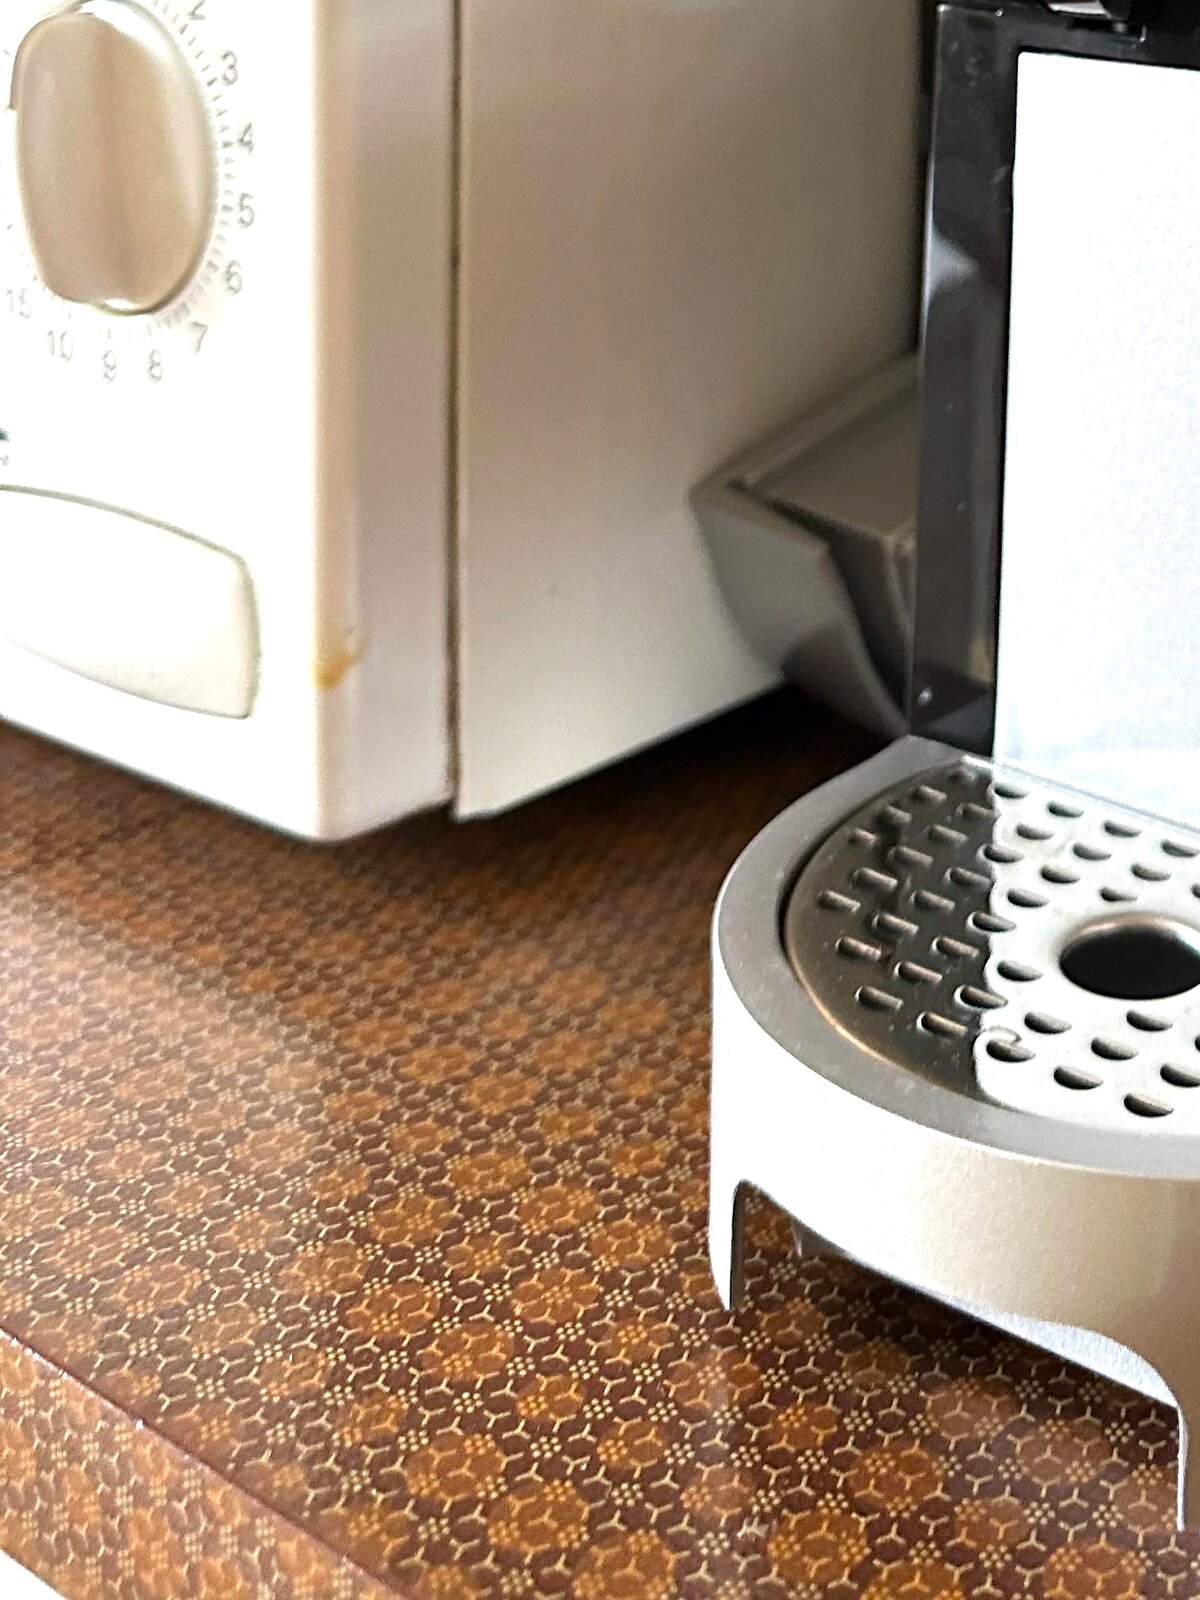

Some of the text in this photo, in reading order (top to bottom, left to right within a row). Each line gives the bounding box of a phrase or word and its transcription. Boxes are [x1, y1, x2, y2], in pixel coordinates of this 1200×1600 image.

[221, 50, 238, 86] 3
[238, 122, 255, 155] 4
[238, 193, 255, 228] 5
[224, 260, 243, 295] 6
[47, 330, 73, 362] 10
[190, 320, 209, 355] 7
[102, 350, 117, 383] 9
[148, 349, 163, 382] 8
